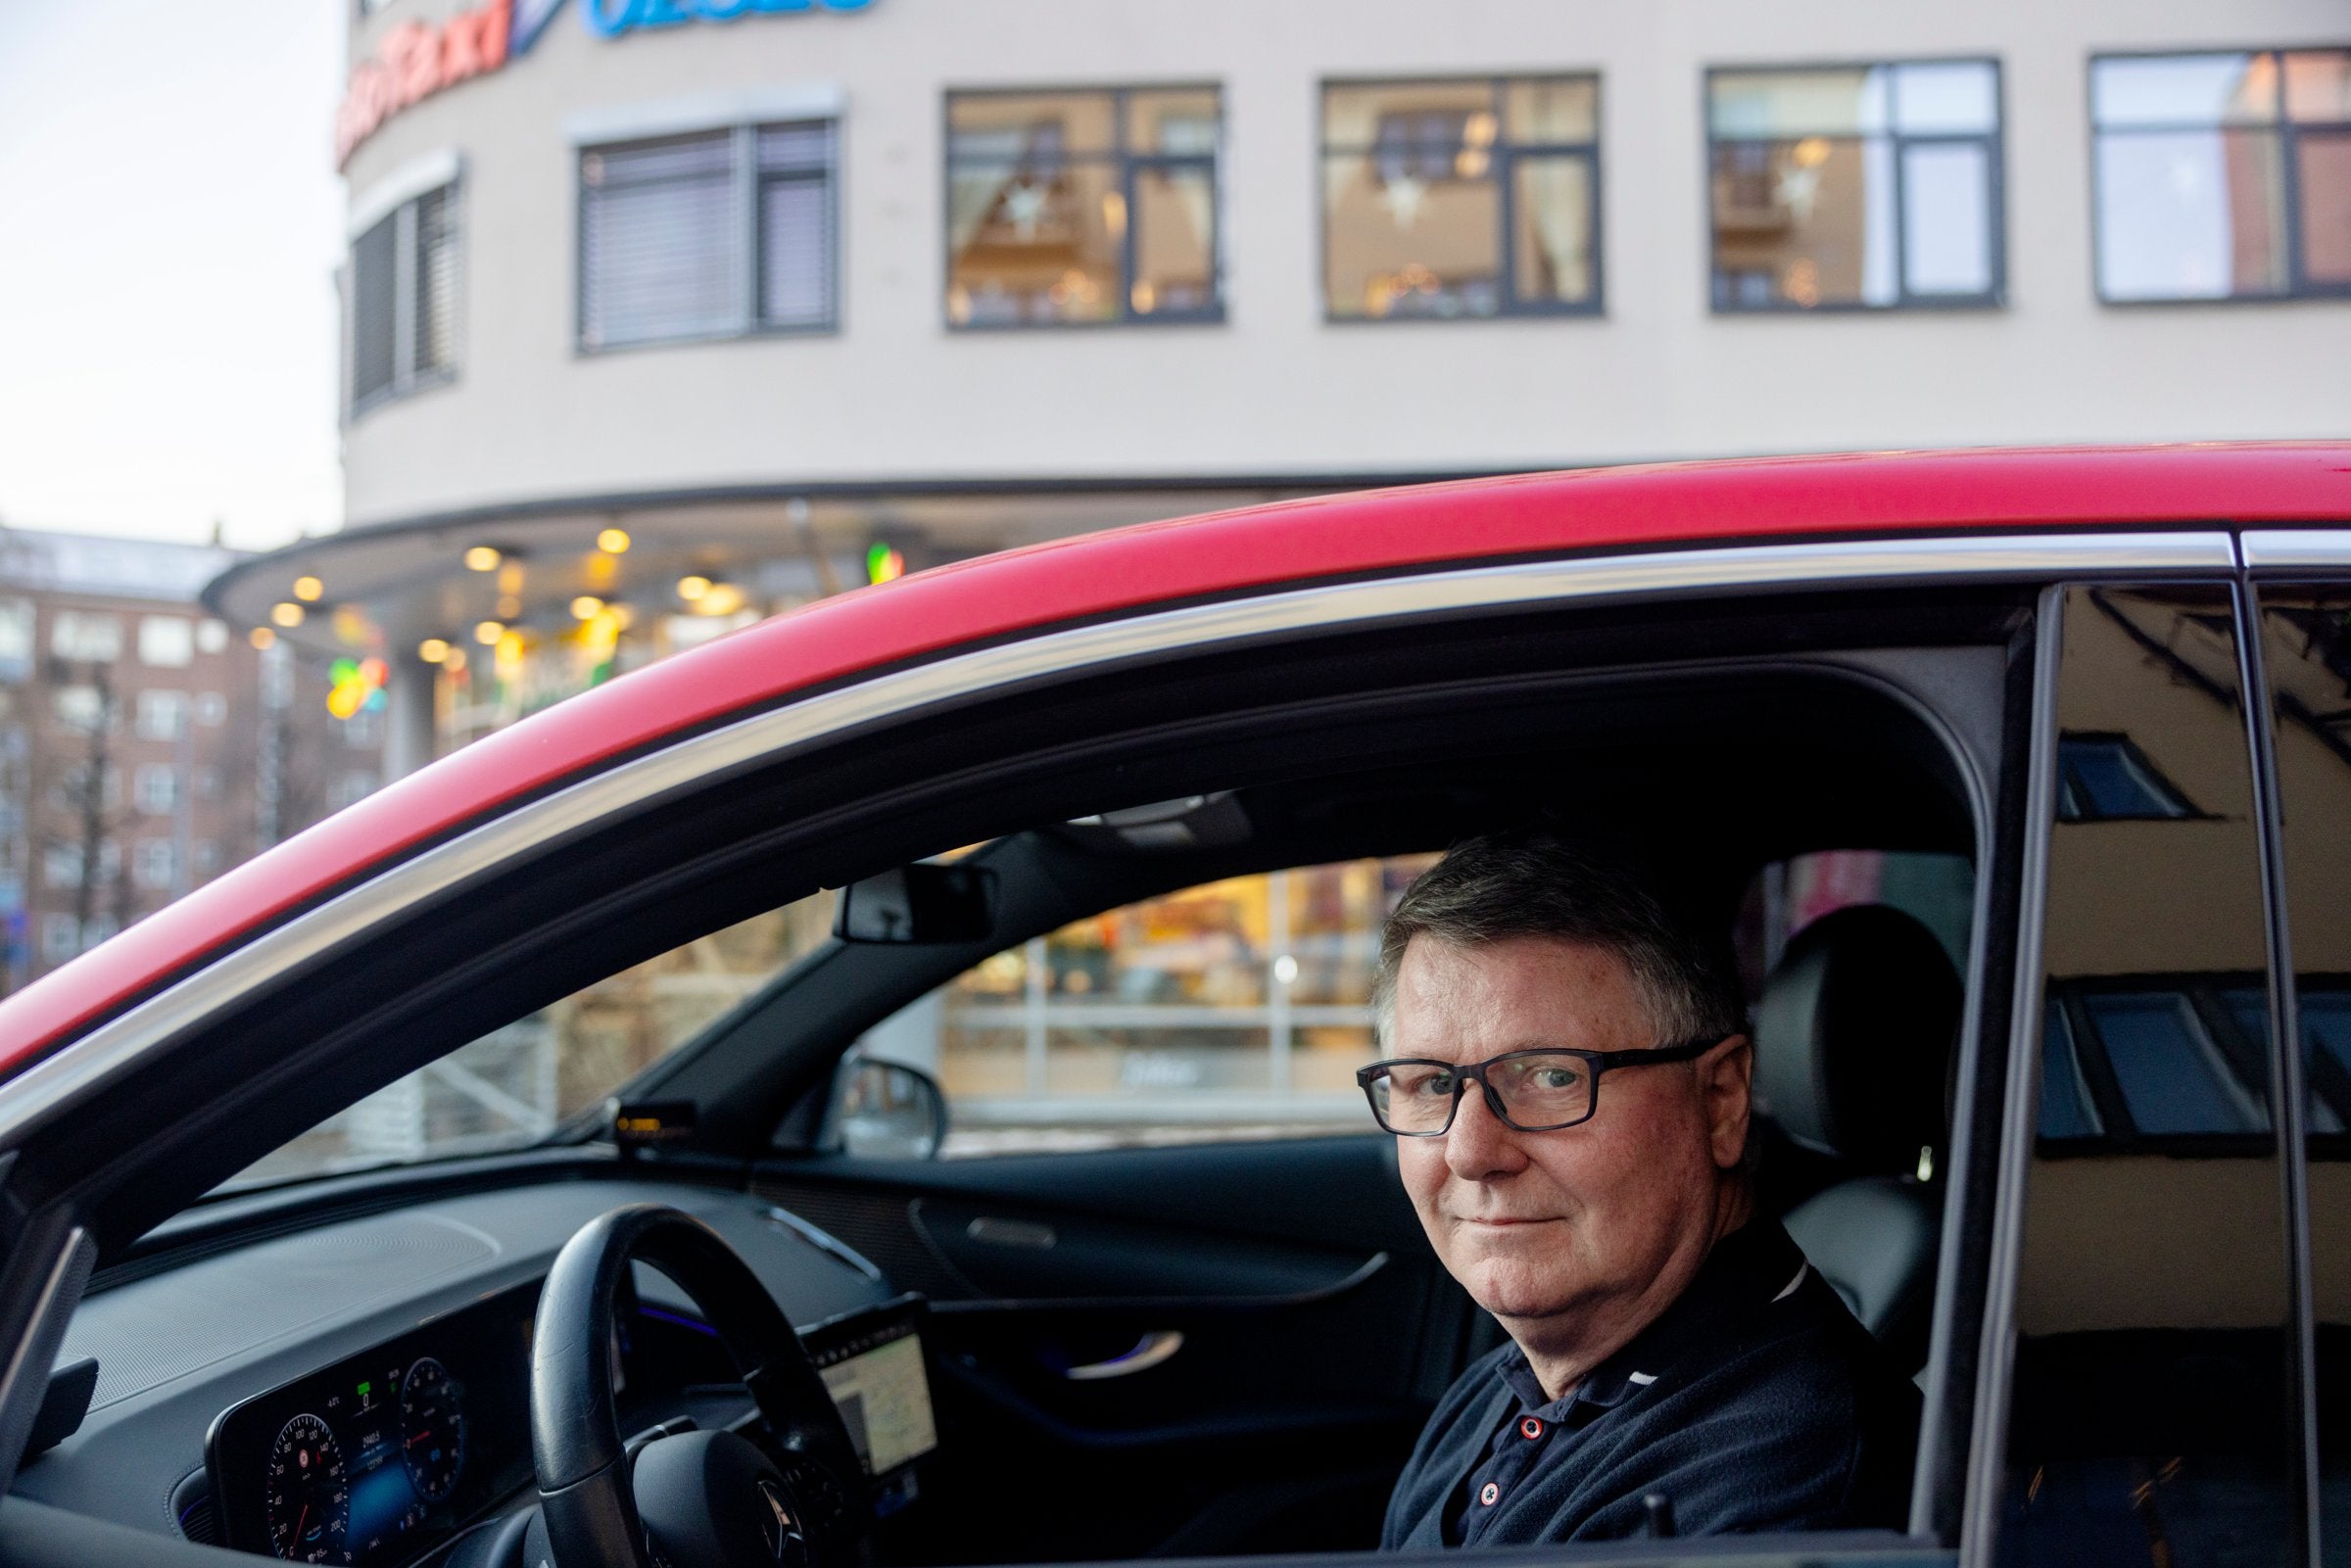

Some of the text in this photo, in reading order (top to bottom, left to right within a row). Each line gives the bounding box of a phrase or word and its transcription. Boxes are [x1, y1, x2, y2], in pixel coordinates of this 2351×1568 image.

[296, 1428, 305, 1440] 100
[309, 1429, 318, 1441] 120
[283, 1442, 292, 1453] 80
[319, 1442, 329, 1453] 140
[276, 1464, 284, 1475] 60
[274, 1495, 282, 1505] 40
[279, 1523, 287, 1535] 20
[330, 1519, 341, 1532] 200
